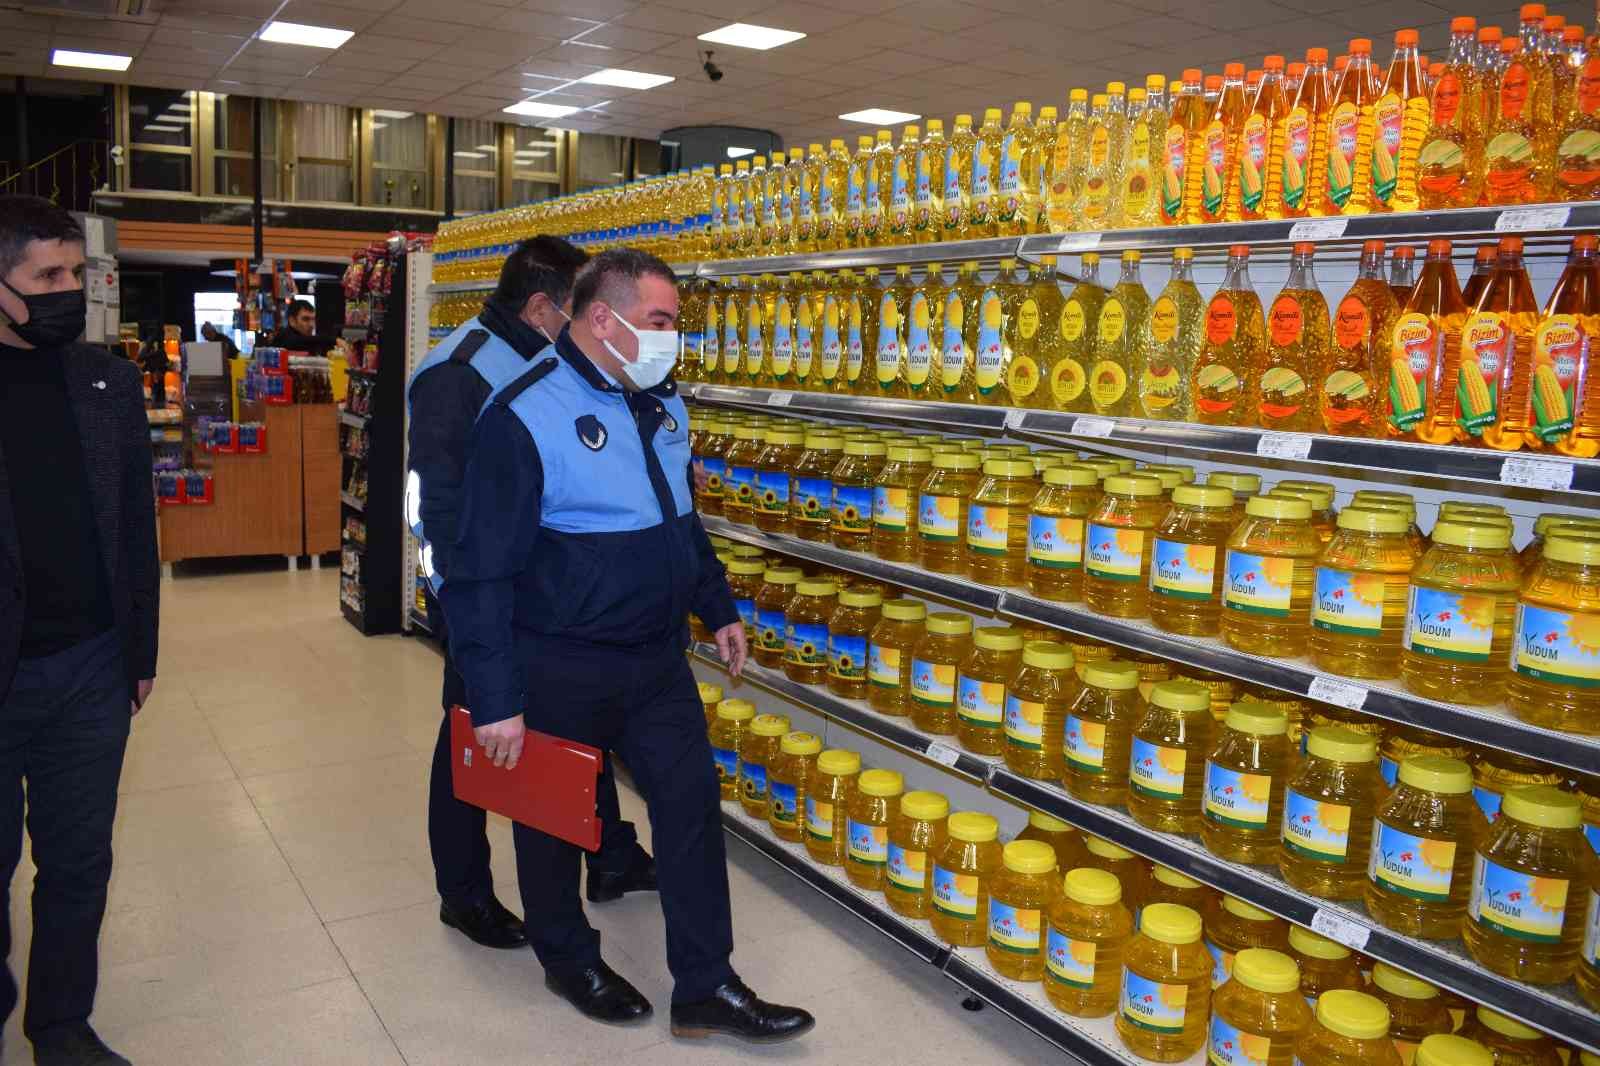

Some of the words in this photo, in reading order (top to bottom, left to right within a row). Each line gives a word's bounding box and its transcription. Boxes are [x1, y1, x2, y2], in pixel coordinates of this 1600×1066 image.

[1399, 328, 1428, 342] Bizim
[1470, 327, 1500, 344] Bizim
[1544, 330, 1577, 346] Bizim
[1418, 612, 1451, 638] YUDUM
[1525, 631, 1558, 661] YUDUM
[1382, 849, 1412, 877] YUDUM
[1488, 888, 1522, 918] YUDUM
